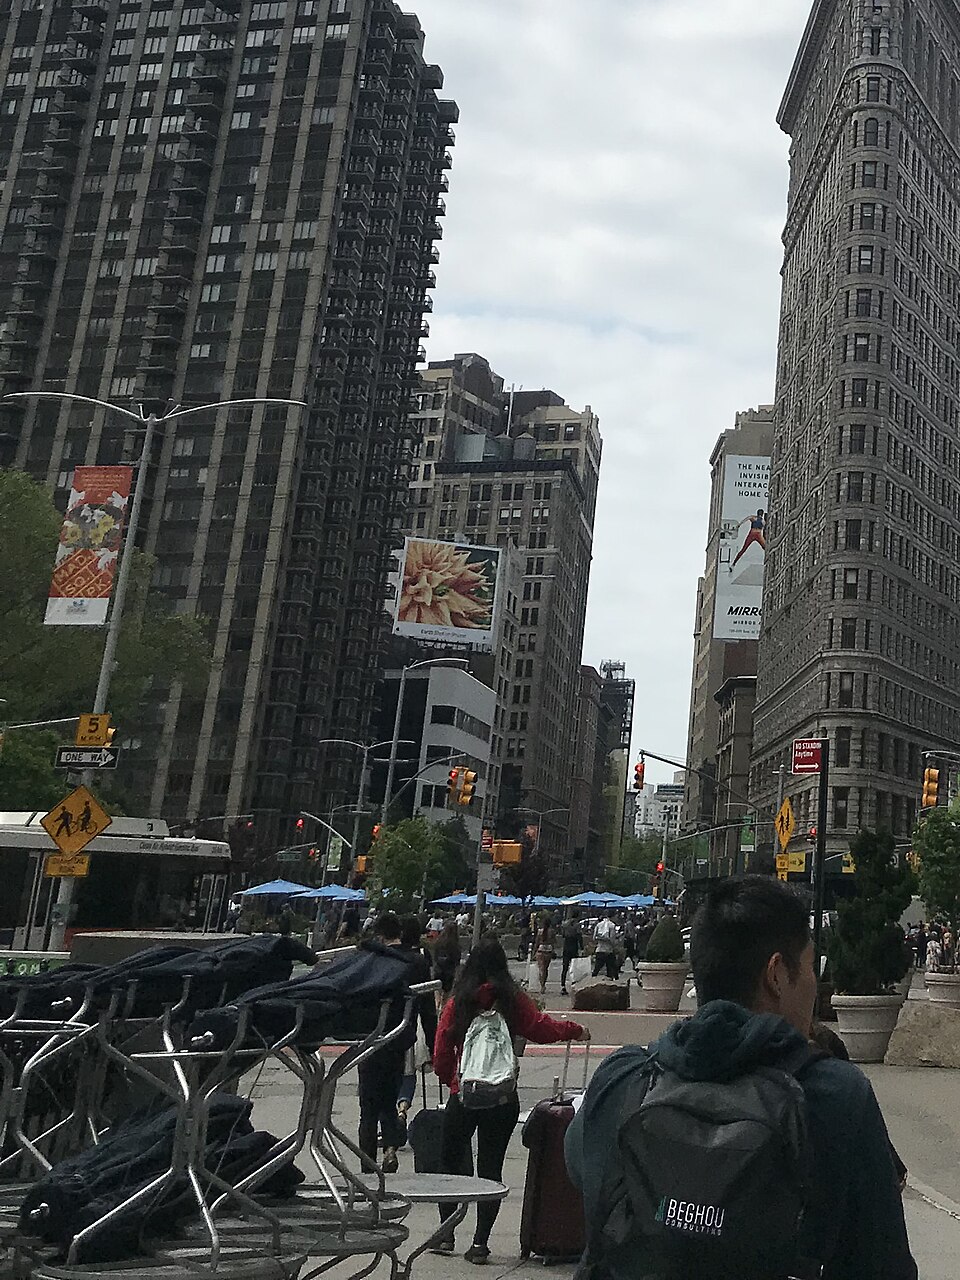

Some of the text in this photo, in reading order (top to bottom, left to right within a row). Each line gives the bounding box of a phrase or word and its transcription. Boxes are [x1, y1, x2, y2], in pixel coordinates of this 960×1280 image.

[740, 472, 769, 480] INVISIB
[734, 481, 768, 489] INTERAC
[738, 490, 761, 498] HOME
[88, 717, 99, 733] 5
[65, 753, 109, 762] ONE WAY
[795, 751, 813, 759] Anytime
[667, 1198, 725, 1228] BEGHOU
[665, 1218, 722, 1236] CONSULTING
